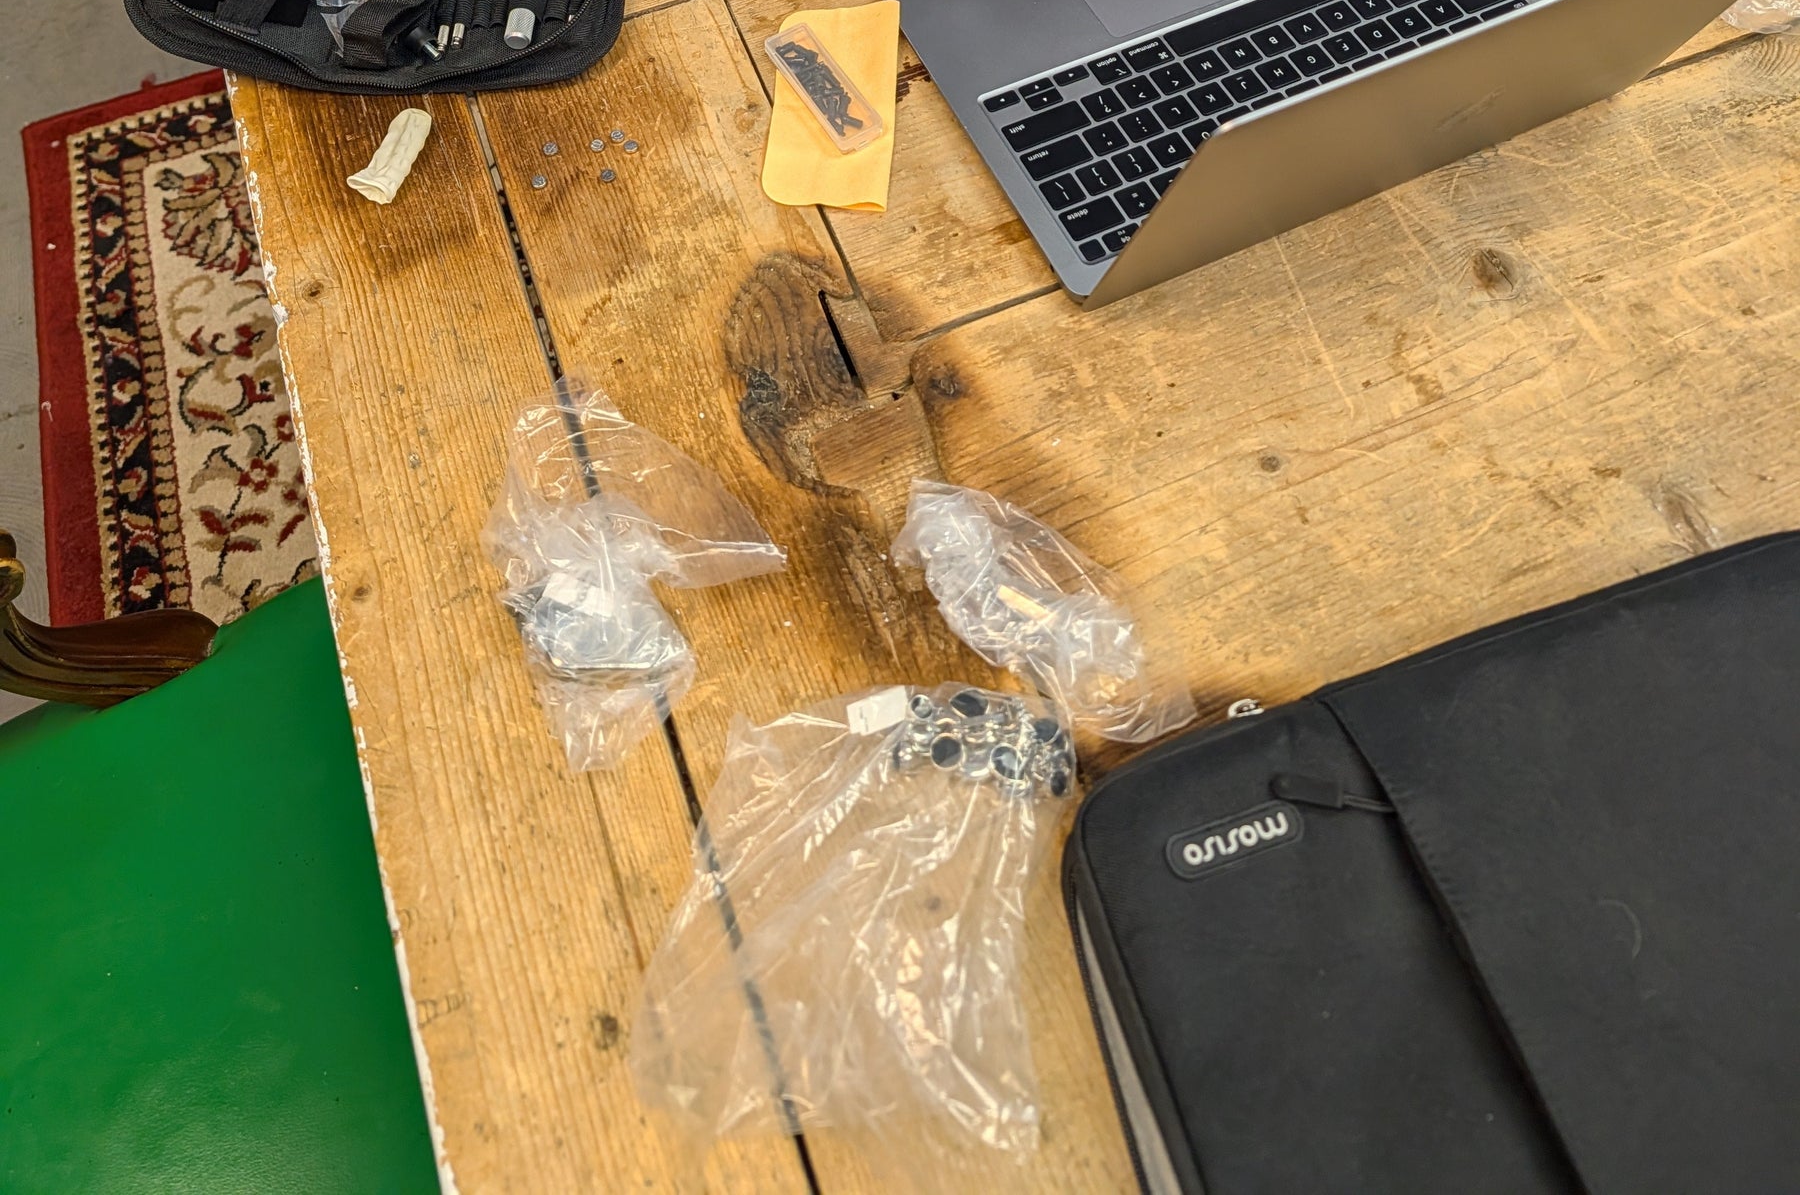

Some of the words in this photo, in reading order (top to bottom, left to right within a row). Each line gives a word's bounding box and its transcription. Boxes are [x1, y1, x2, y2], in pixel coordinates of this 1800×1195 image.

[1365, 0, 1376, 8] X
[1435, 5, 1445, 14] A
[1334, 11, 1344, 20] C
[1404, 17, 1414, 26] S
[1302, 24, 1312, 33] V
[1372, 30, 1383, 38] D
[1268, 36, 1279, 45] B
[1128, 41, 1159, 57] command
[1341, 43, 1350, 52] F
[1096, 56, 1117, 68] option
[1306, 55, 1317, 64] G
[1205, 93, 1216, 103] K
[1171, 107, 1181, 115] L
[1009, 124, 1026, 134] shift
[1167, 144, 1177, 154] P
[1027, 150, 1049, 162] return
[1066, 208, 1089, 221] delete
[1183, 812, 1289, 866] mosiso
